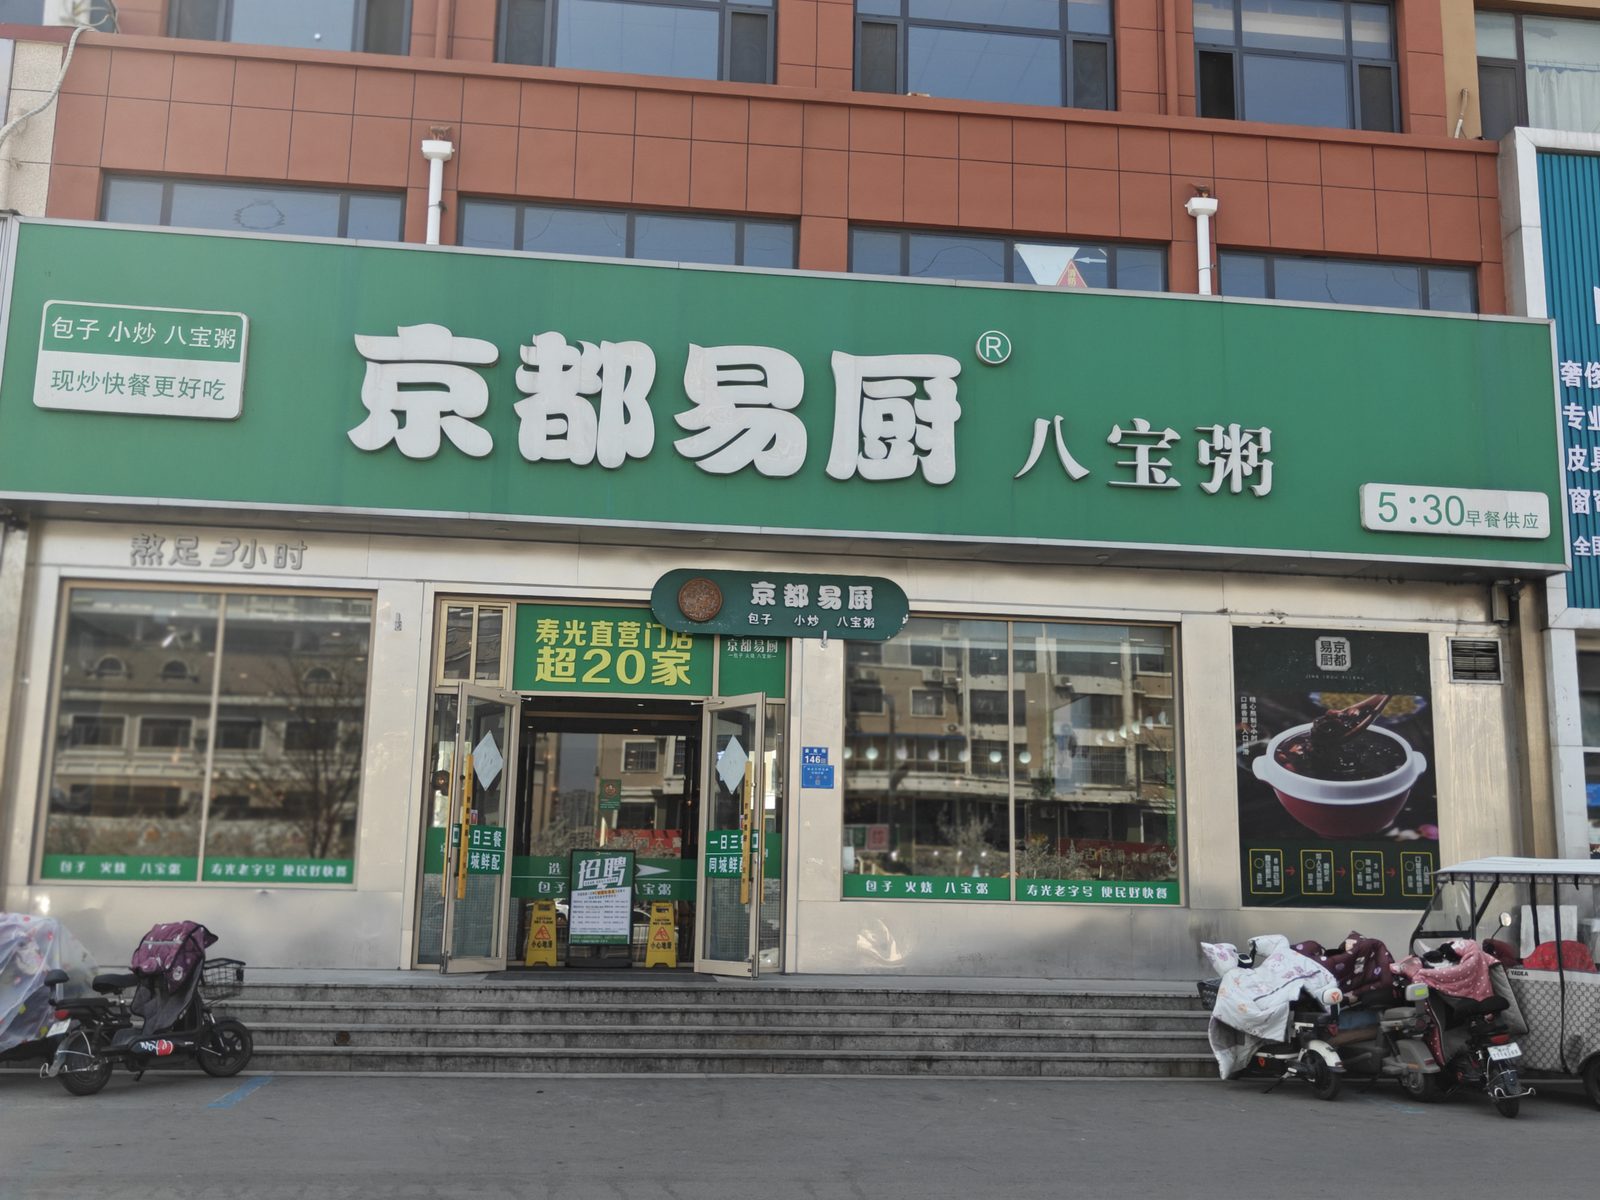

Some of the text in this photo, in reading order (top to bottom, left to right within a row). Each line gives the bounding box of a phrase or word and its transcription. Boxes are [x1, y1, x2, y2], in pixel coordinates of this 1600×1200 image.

[51, 316, 236, 350] 包子 小炒 八宝粥
[50, 369, 226, 401] 现炒快餐更好吃
[347, 323, 962, 486] 京都易厨
[1014, 414, 1274, 498] 八宝粥
[130, 533, 308, 570] 熬足3小时
[750, 581, 873, 610] 京都易厨
[535, 618, 693, 649] 寿光直营门店
[748, 612, 875, 629] 包子 小炒 八宝粥
[535, 645, 691, 686] 超20家
[468, 829, 502, 847] 日三餐
[709, 834, 743, 850] 一日三
[466, 852, 501, 870] 城鲜配
[577, 856, 627, 889] 招聘
[708, 856, 743, 873] 同城鲜
[538, 881, 567, 893] 包子
[866, 880, 989, 894] 包子 火烧 八宝粥
[1026, 884, 1093, 898] 寿光老字号
